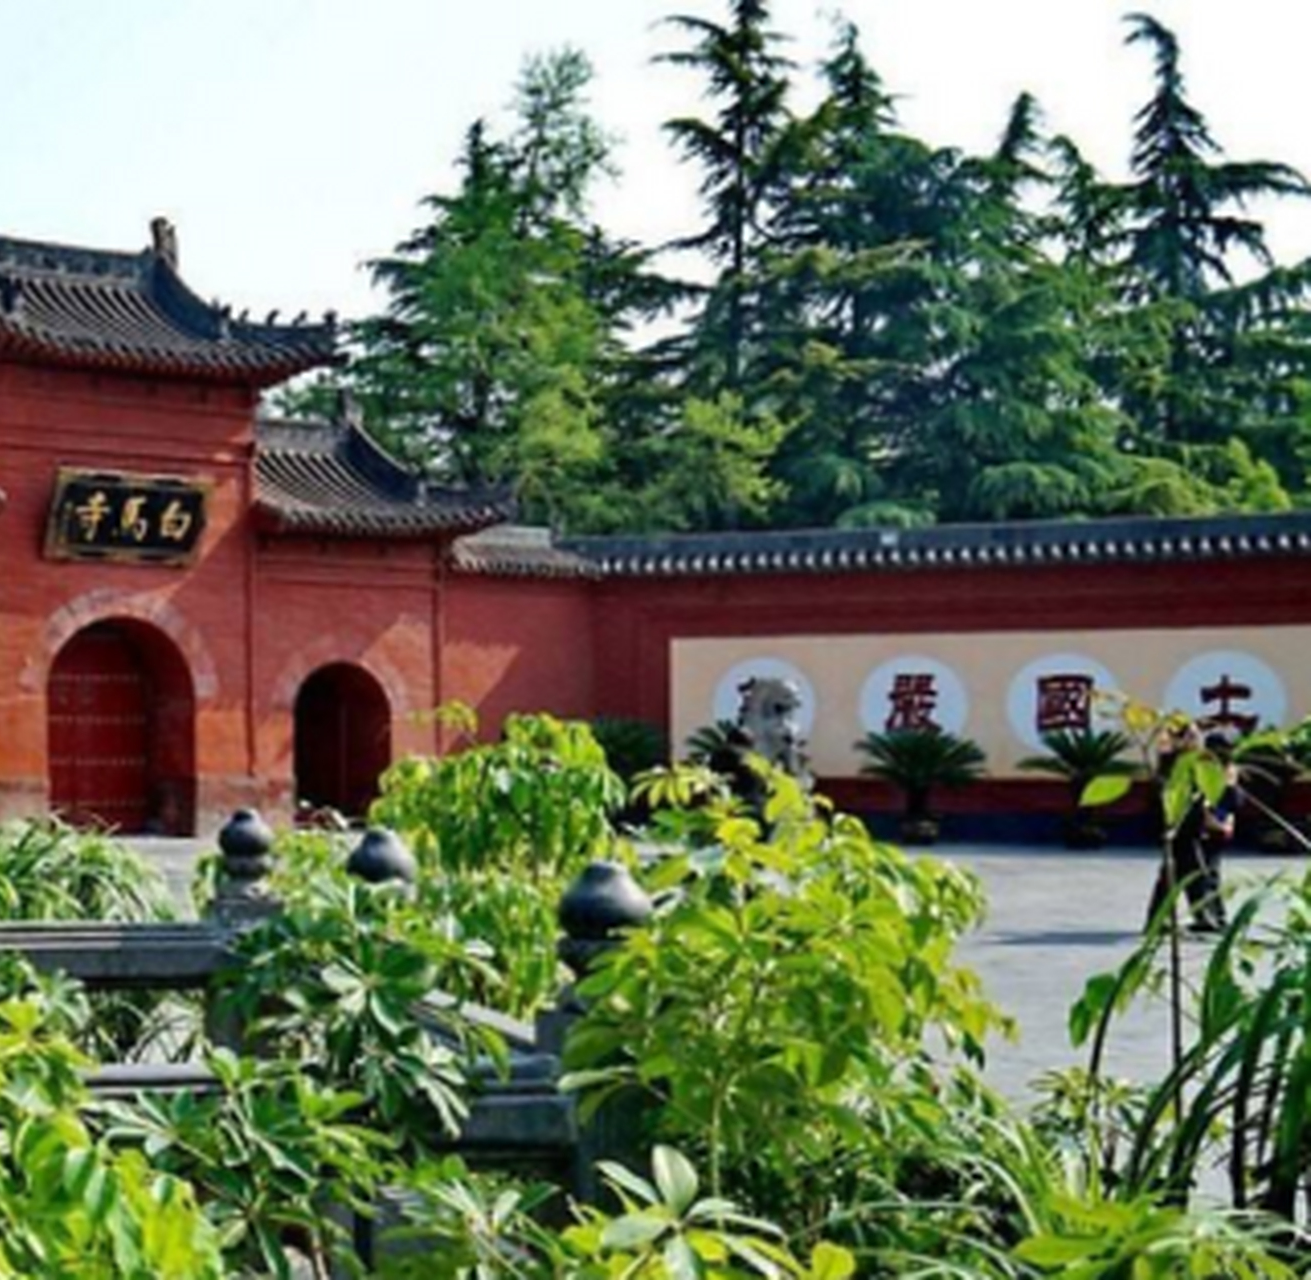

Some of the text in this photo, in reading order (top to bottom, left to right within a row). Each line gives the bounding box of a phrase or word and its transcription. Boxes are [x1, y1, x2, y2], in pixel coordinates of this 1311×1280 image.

[76, 490, 192, 543] 白馬寺
[736, 672, 1259, 734] 嚴國土
